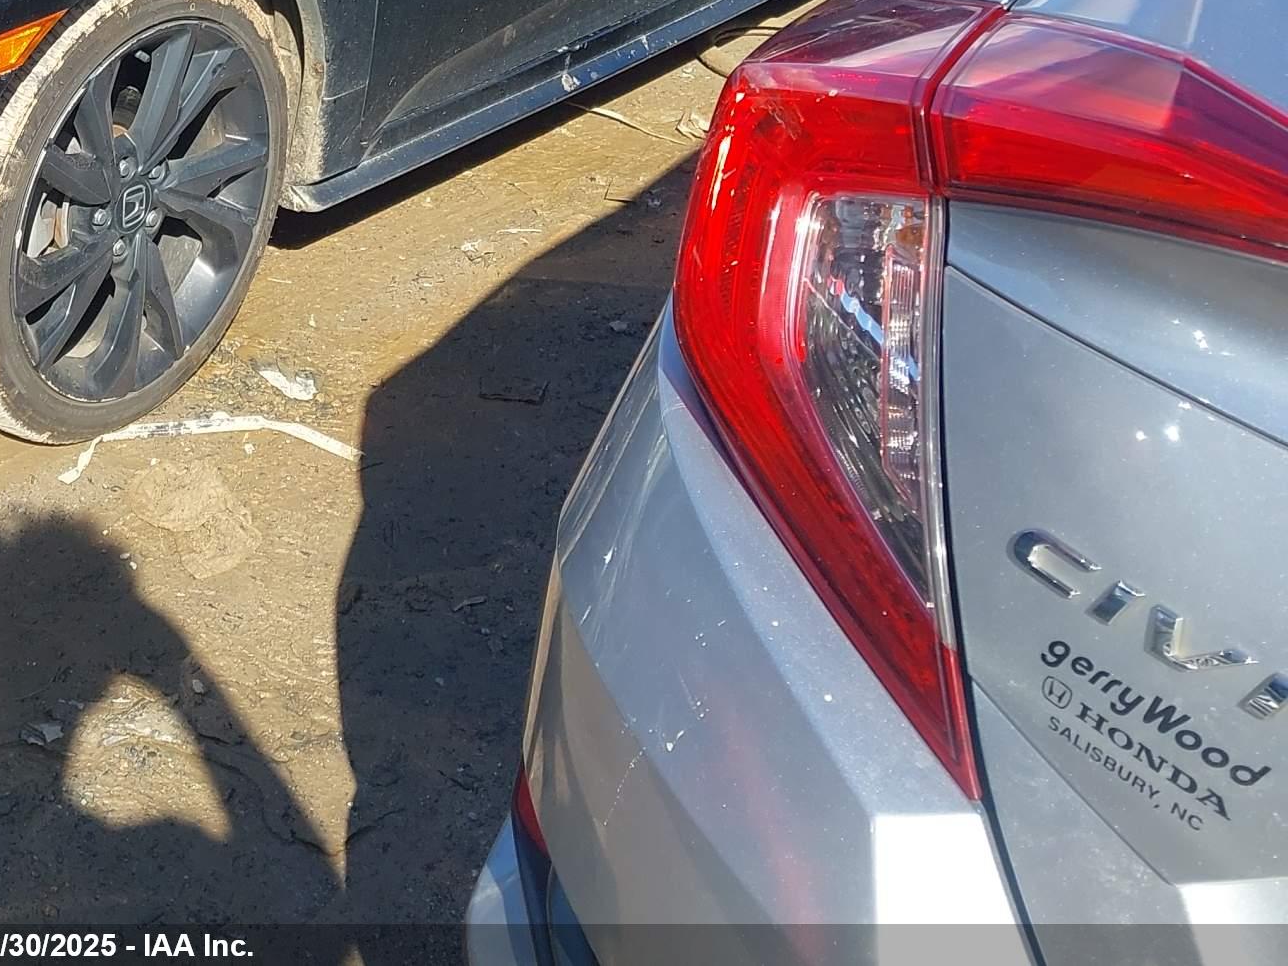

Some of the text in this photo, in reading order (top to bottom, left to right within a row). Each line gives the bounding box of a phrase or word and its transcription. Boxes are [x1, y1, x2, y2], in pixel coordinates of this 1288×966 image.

[1040, 640, 1272, 786] gerryWood
[1047, 715, 1204, 831] SALISBURY, NC
[1076, 701, 1231, 821] HONDA
